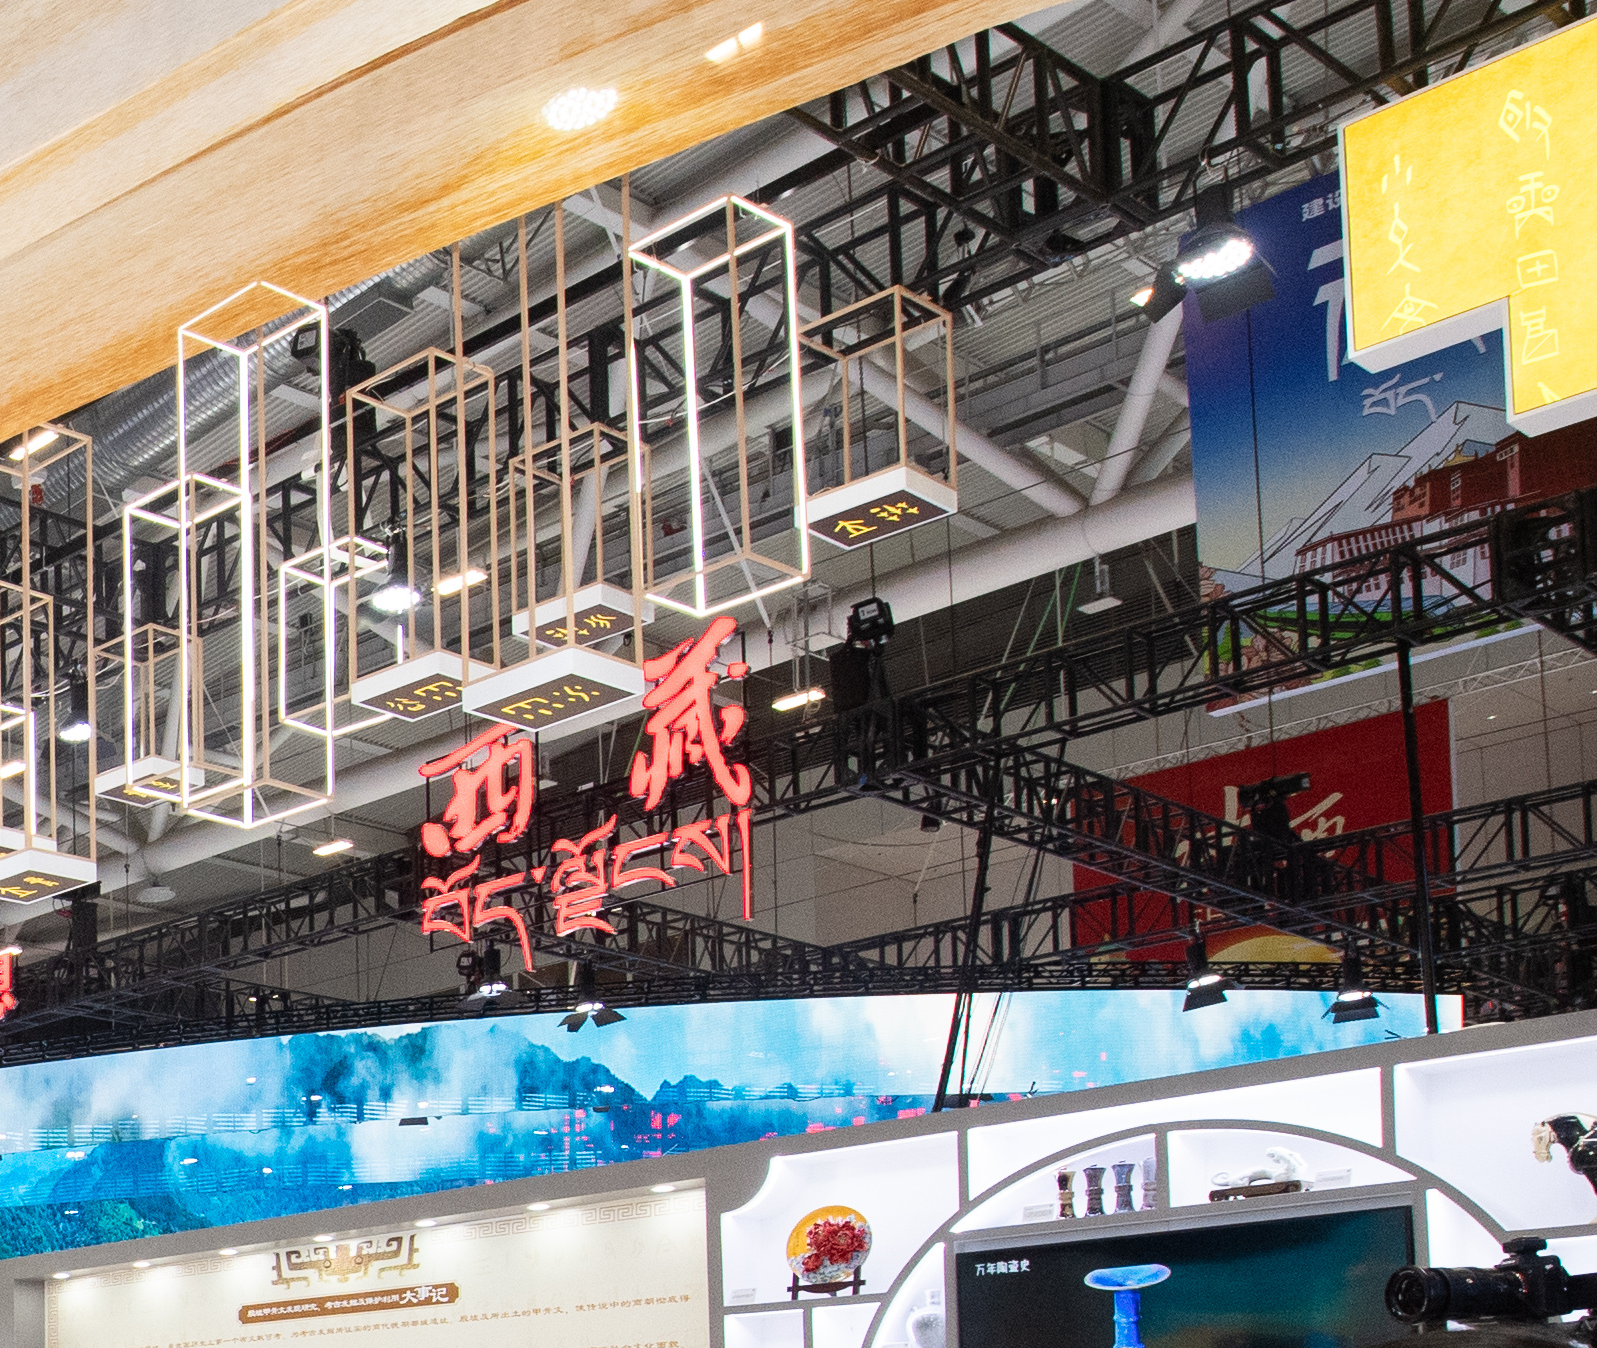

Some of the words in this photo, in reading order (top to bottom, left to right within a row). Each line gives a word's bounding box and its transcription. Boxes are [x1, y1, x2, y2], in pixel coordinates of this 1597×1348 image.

[418, 615, 752, 857] 西藏
[975, 1258, 1030, 1276] 万年陶瓷史
